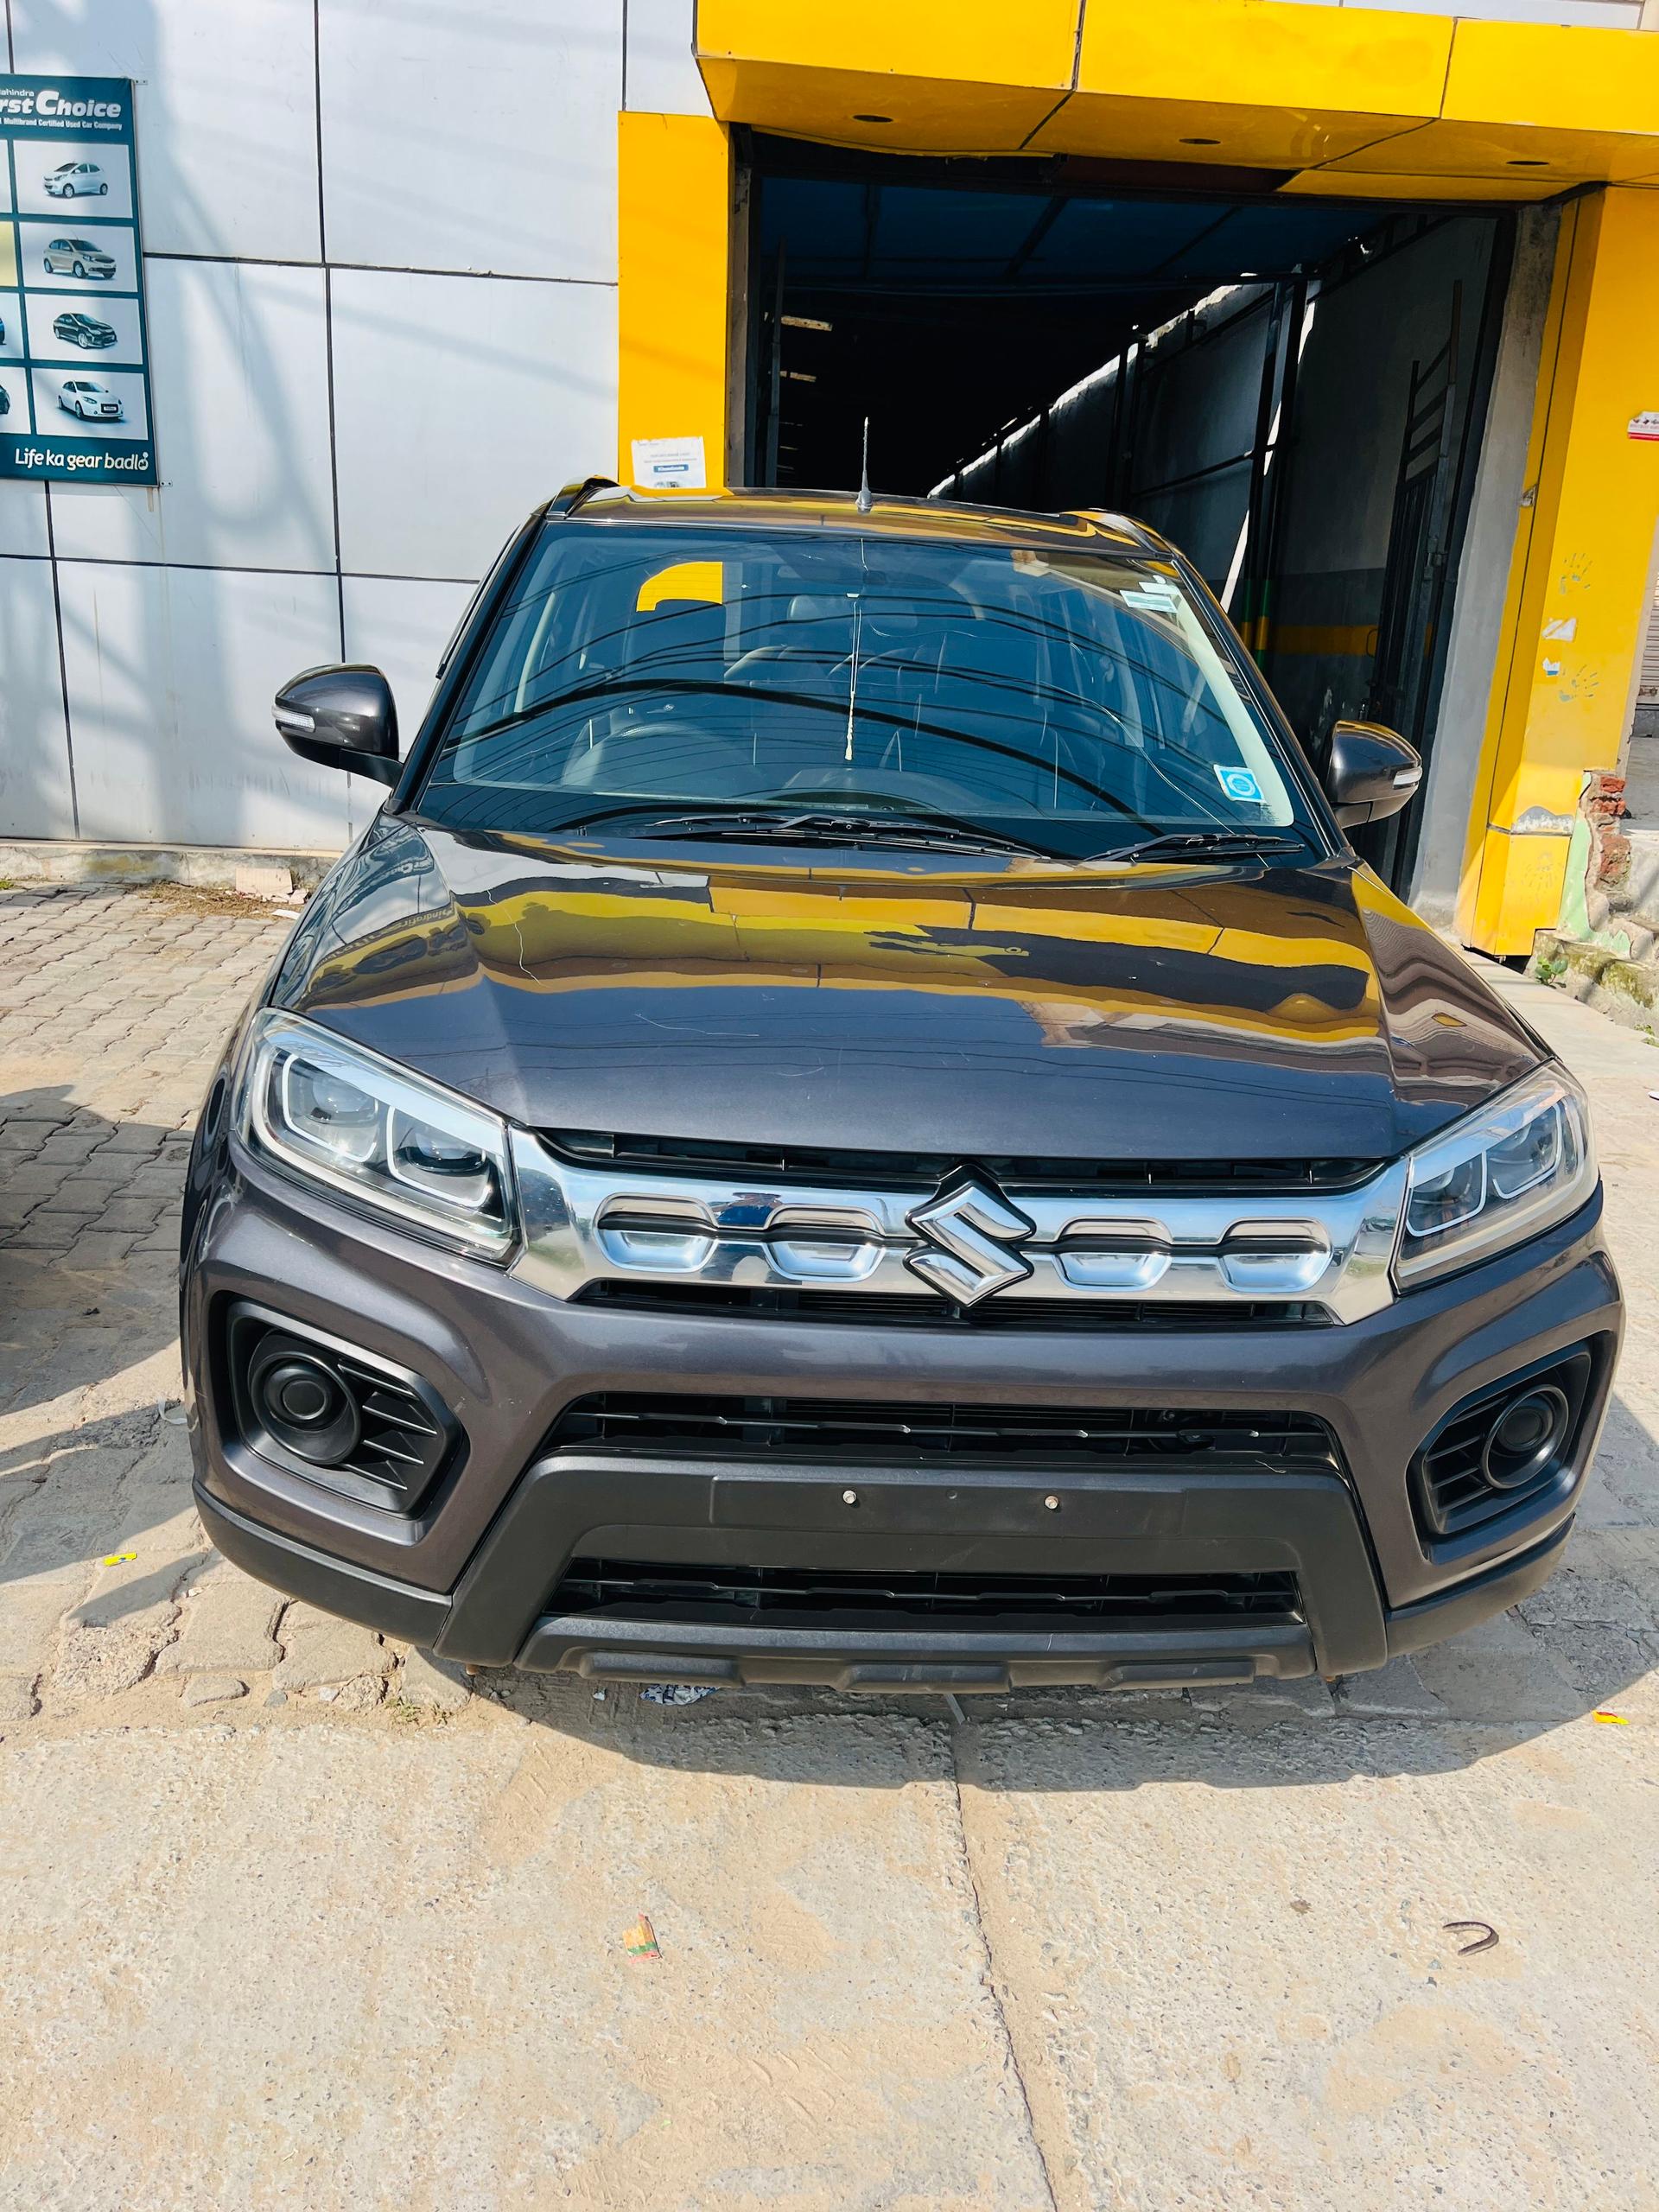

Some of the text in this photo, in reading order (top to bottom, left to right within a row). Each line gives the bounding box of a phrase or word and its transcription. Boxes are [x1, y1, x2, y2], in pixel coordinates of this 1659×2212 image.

[36, 91, 122, 118] Choice
[94, 122, 123, 130] Company
[15, 448, 149, 471] Life ka gear badlo
